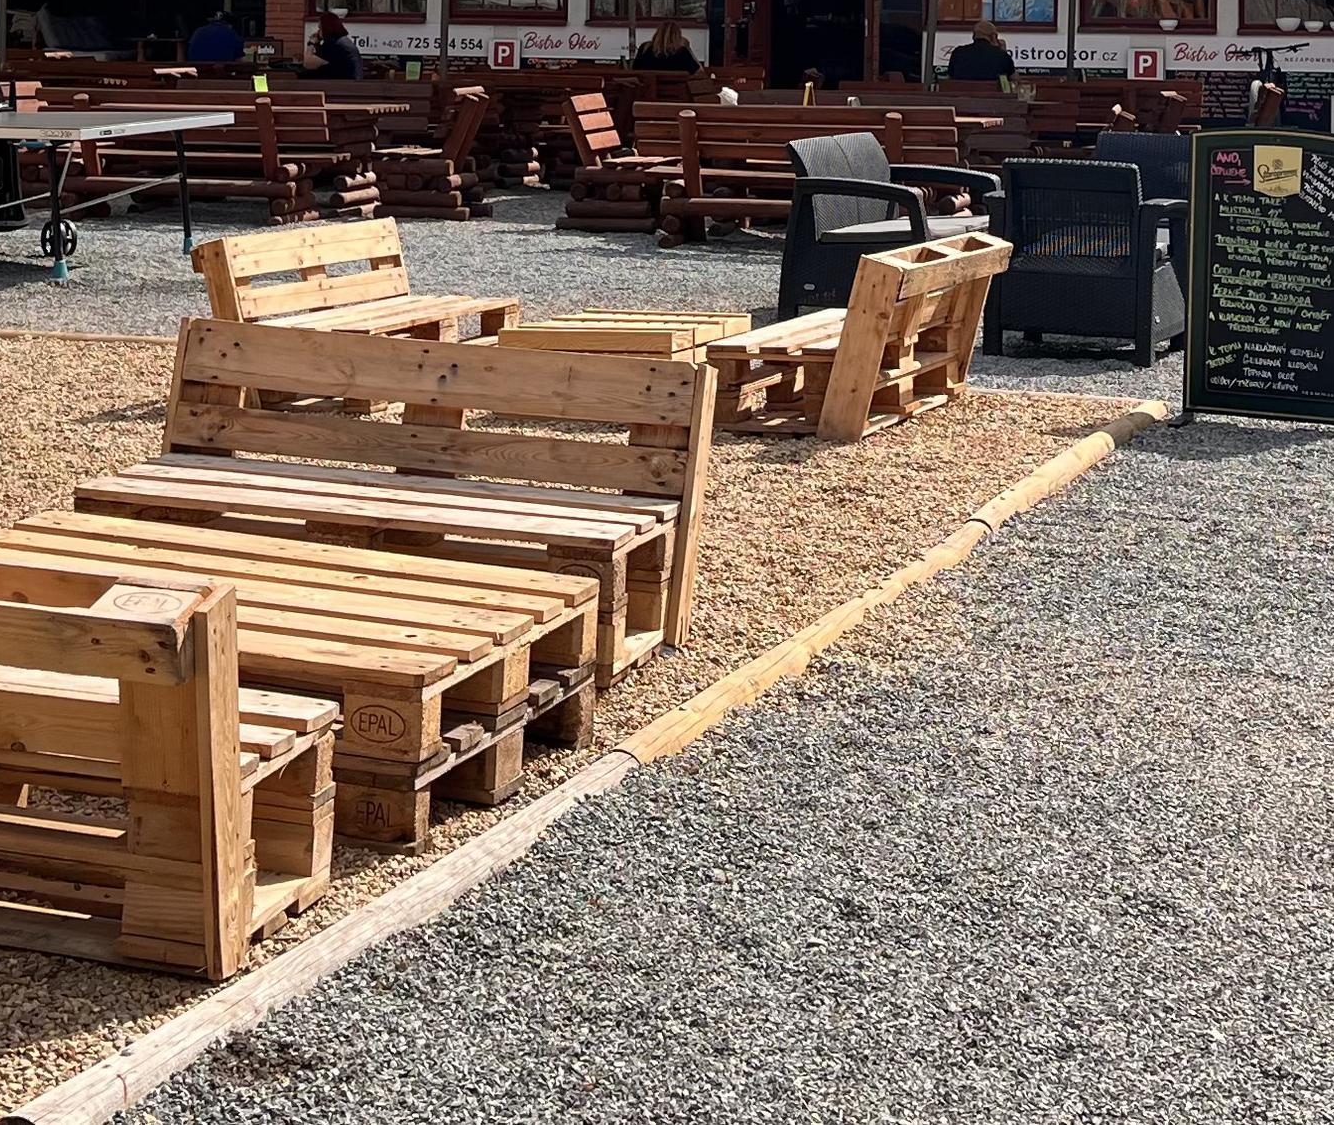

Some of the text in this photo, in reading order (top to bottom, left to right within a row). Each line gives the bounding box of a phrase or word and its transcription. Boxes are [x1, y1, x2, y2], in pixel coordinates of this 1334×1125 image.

[407, 37, 429, 49] 725
[434, 37, 457, 50] 54
[460, 37, 484, 50] 554
[524, 31, 563, 51] Bistro
[496, 45, 511, 64] P
[1173, 42, 1218, 62] Bistro
[1138, 54, 1153, 74] P
[358, 712, 398, 737] EPAL
